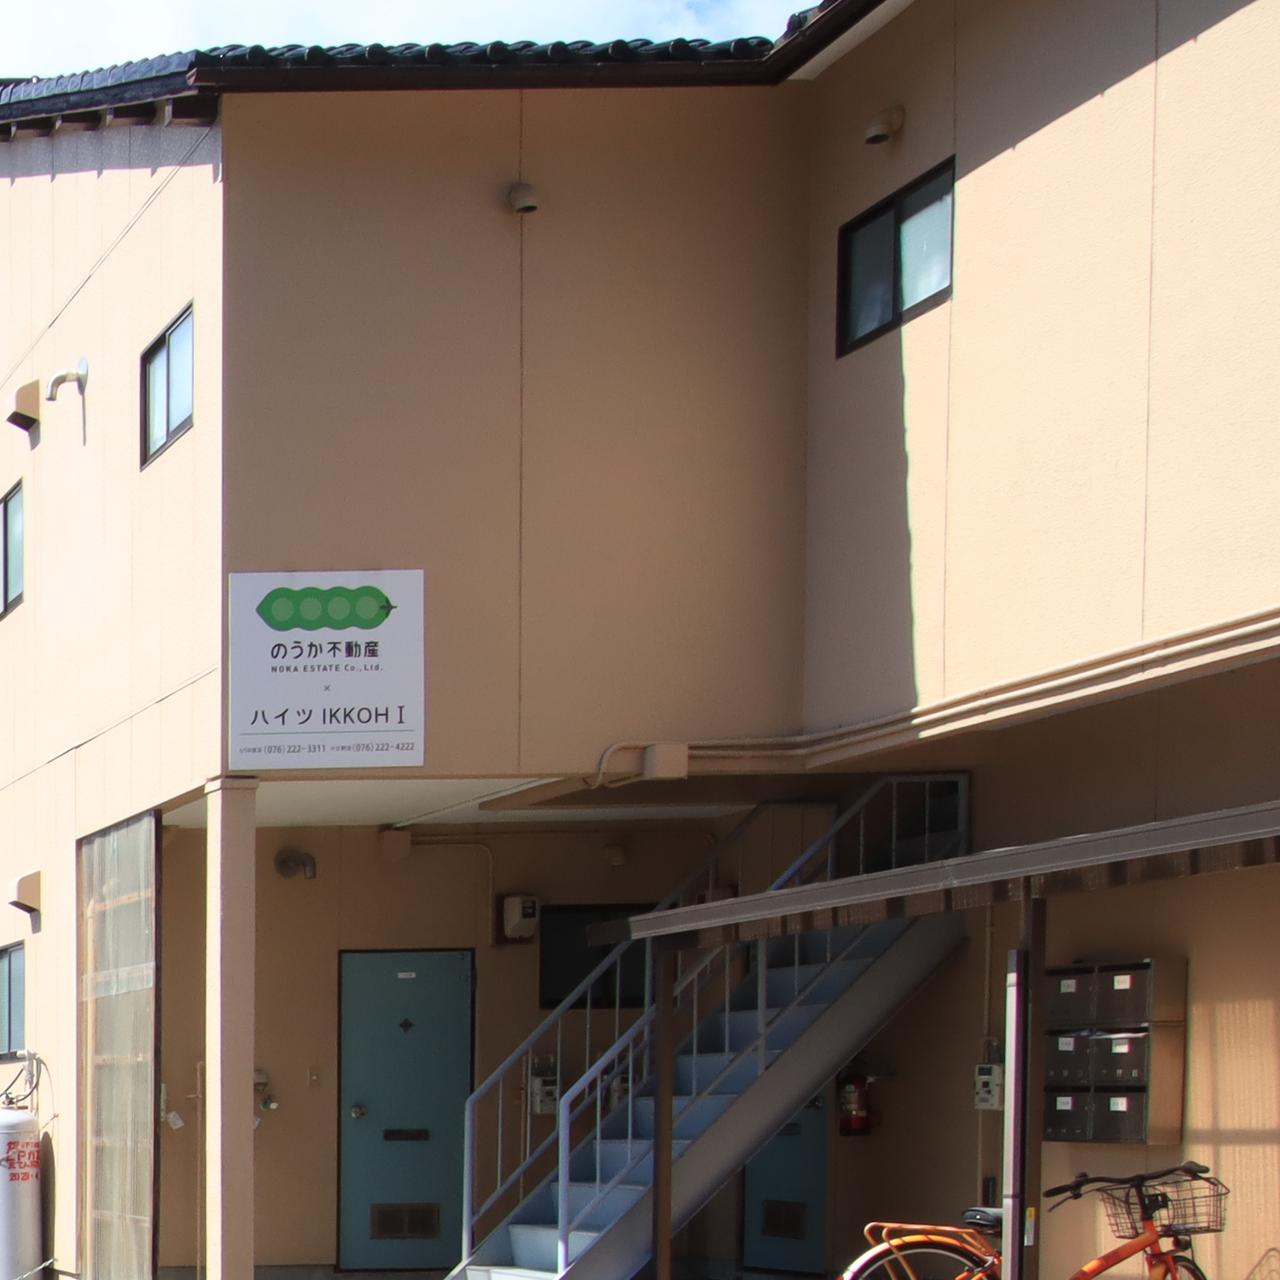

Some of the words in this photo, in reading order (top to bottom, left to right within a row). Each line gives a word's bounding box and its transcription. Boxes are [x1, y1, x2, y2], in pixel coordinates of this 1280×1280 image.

[271, 641, 379, 660] のうか不動産
[271, 665, 299, 673] NOKA
[303, 664, 340, 673] ESTATE
[250, 708, 313, 726] ハイツ
[322, 706, 389, 725] IKKOH
